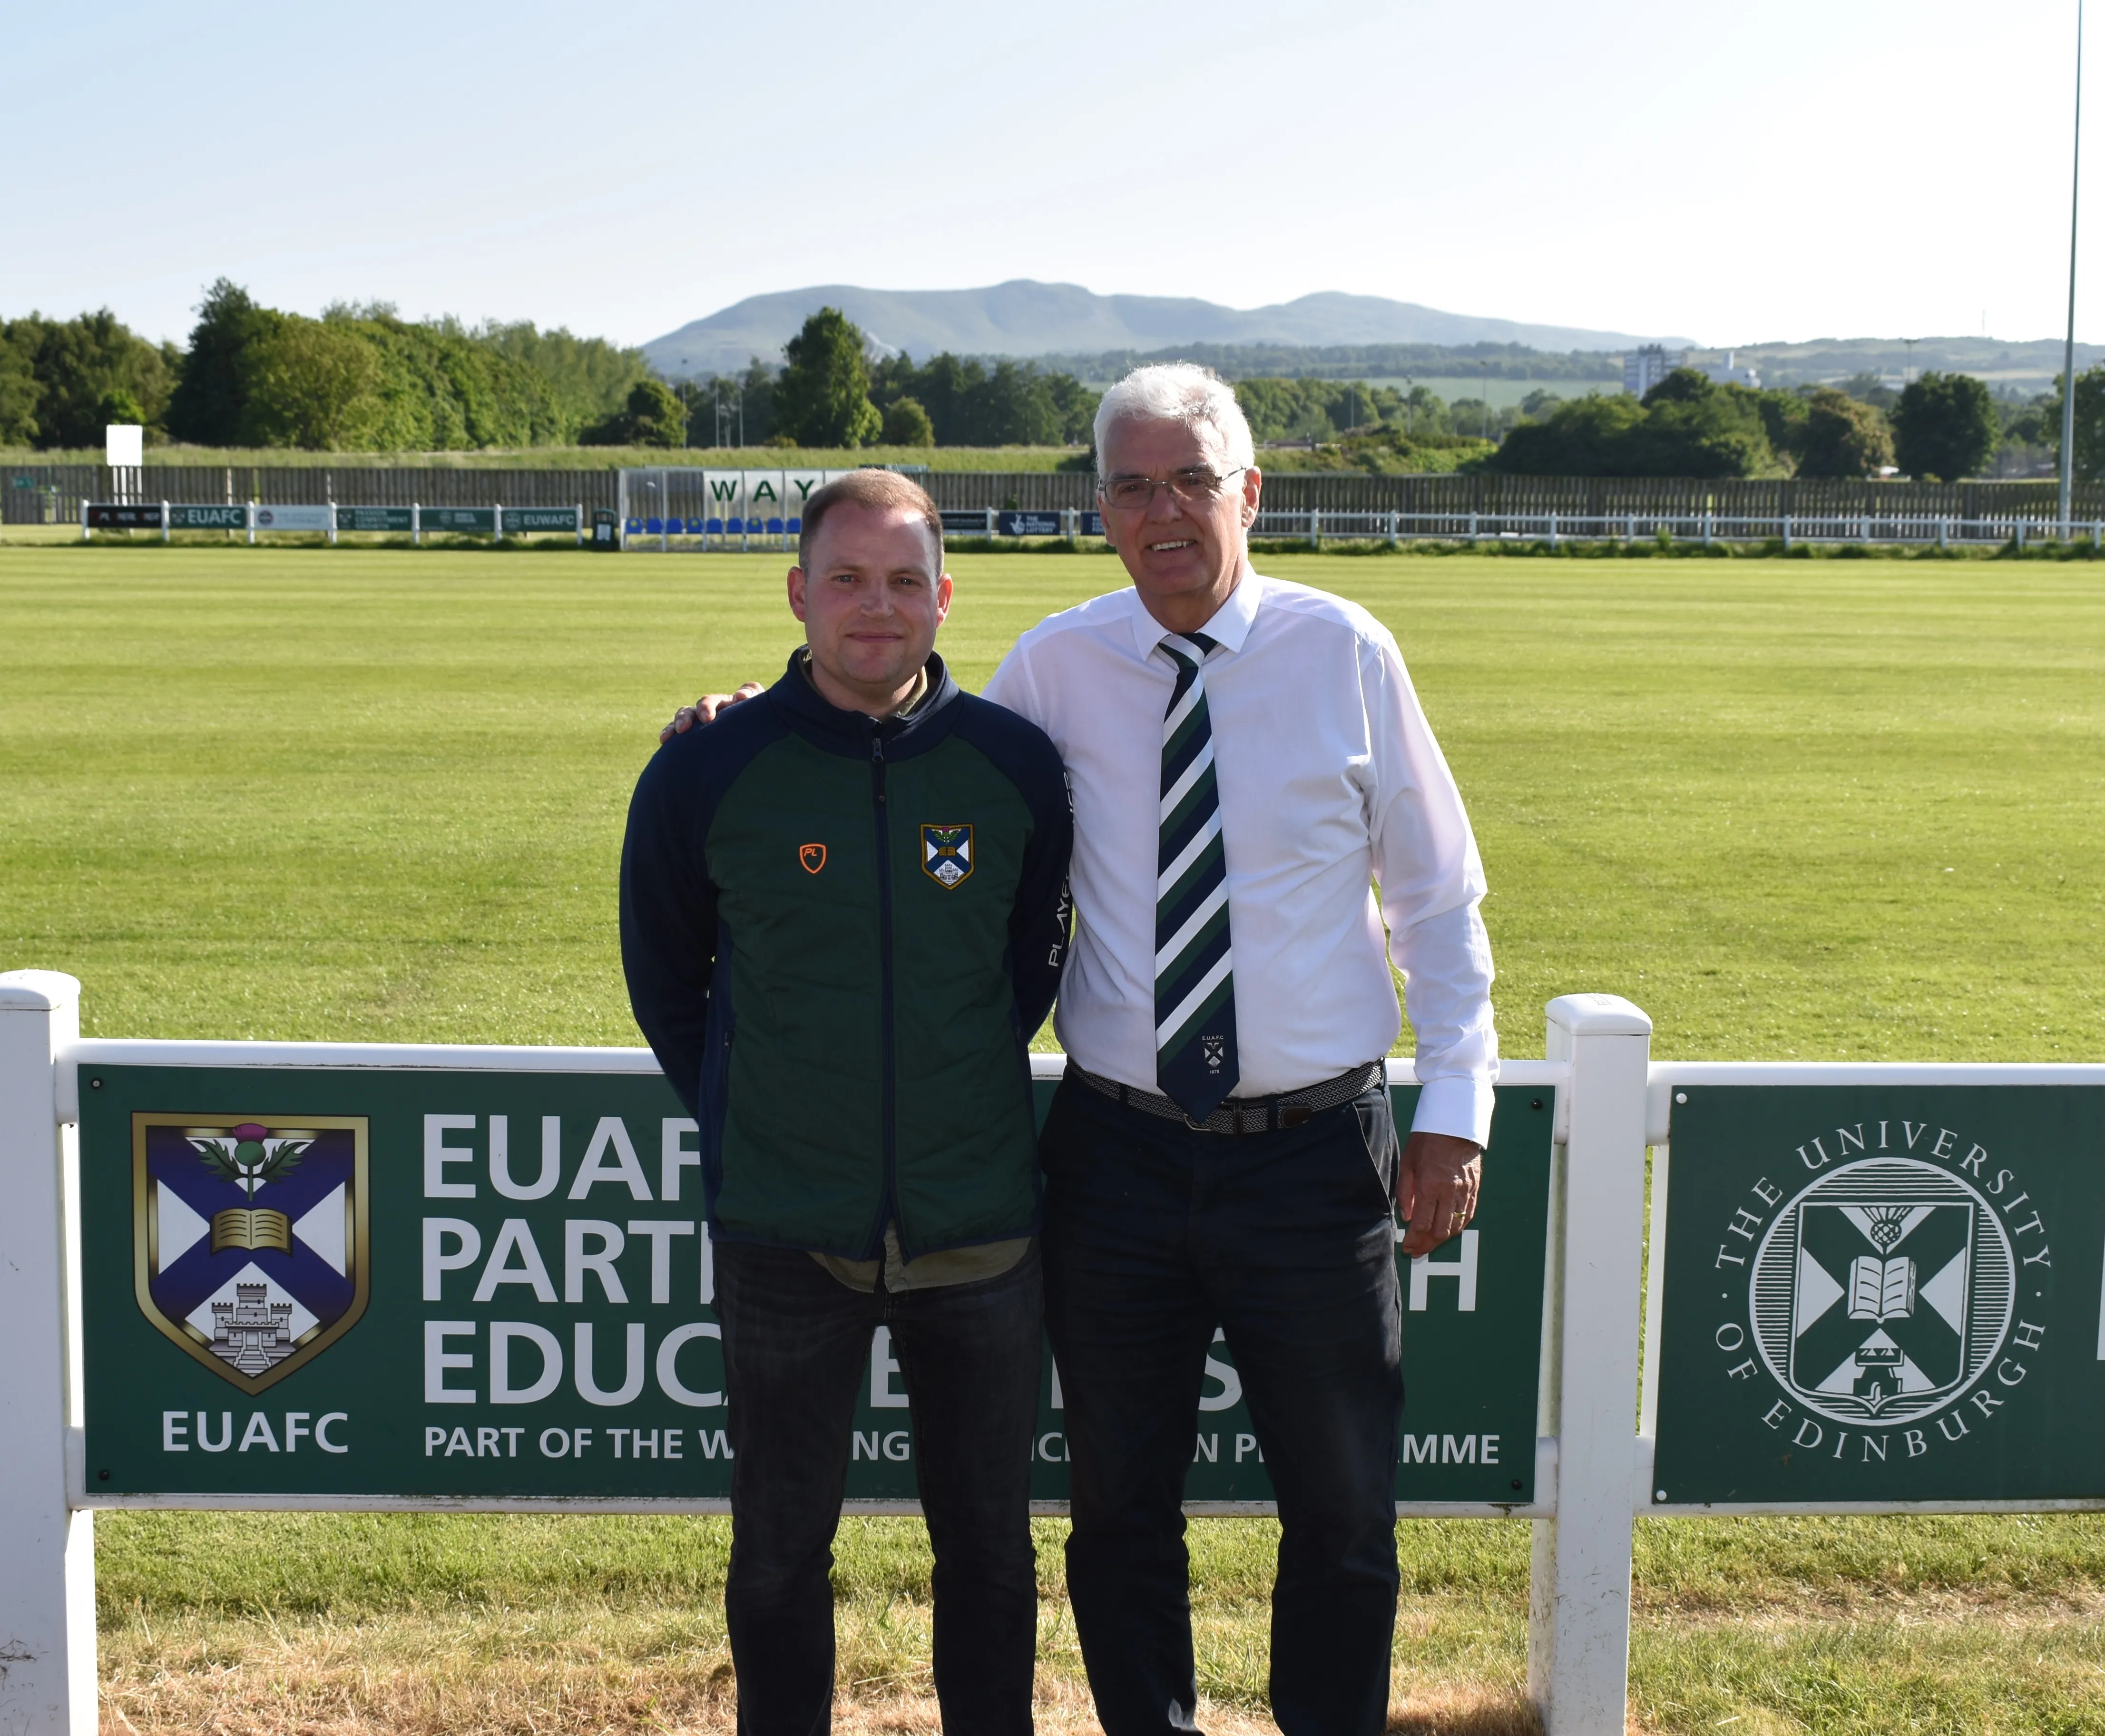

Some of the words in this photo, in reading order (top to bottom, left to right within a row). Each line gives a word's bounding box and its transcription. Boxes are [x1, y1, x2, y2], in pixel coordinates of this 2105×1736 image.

[187, 509, 241, 524] EUAFC
[523, 514, 575, 526] EUWAFC
[804, 848, 817, 856] PL
[1714, 1177, 1783, 1269] THE
[1795, 1121, 2051, 1268] UNIVERSITY
[1715, 1323, 1758, 1380] OF
[1761, 1319, 2046, 1462] EDINBURGH
[162, 1410, 349, 1453] EUAFC
[425, 1427, 525, 1458] PART
[539, 1428, 592, 1458] OF
[606, 1429, 683, 1458] THE
